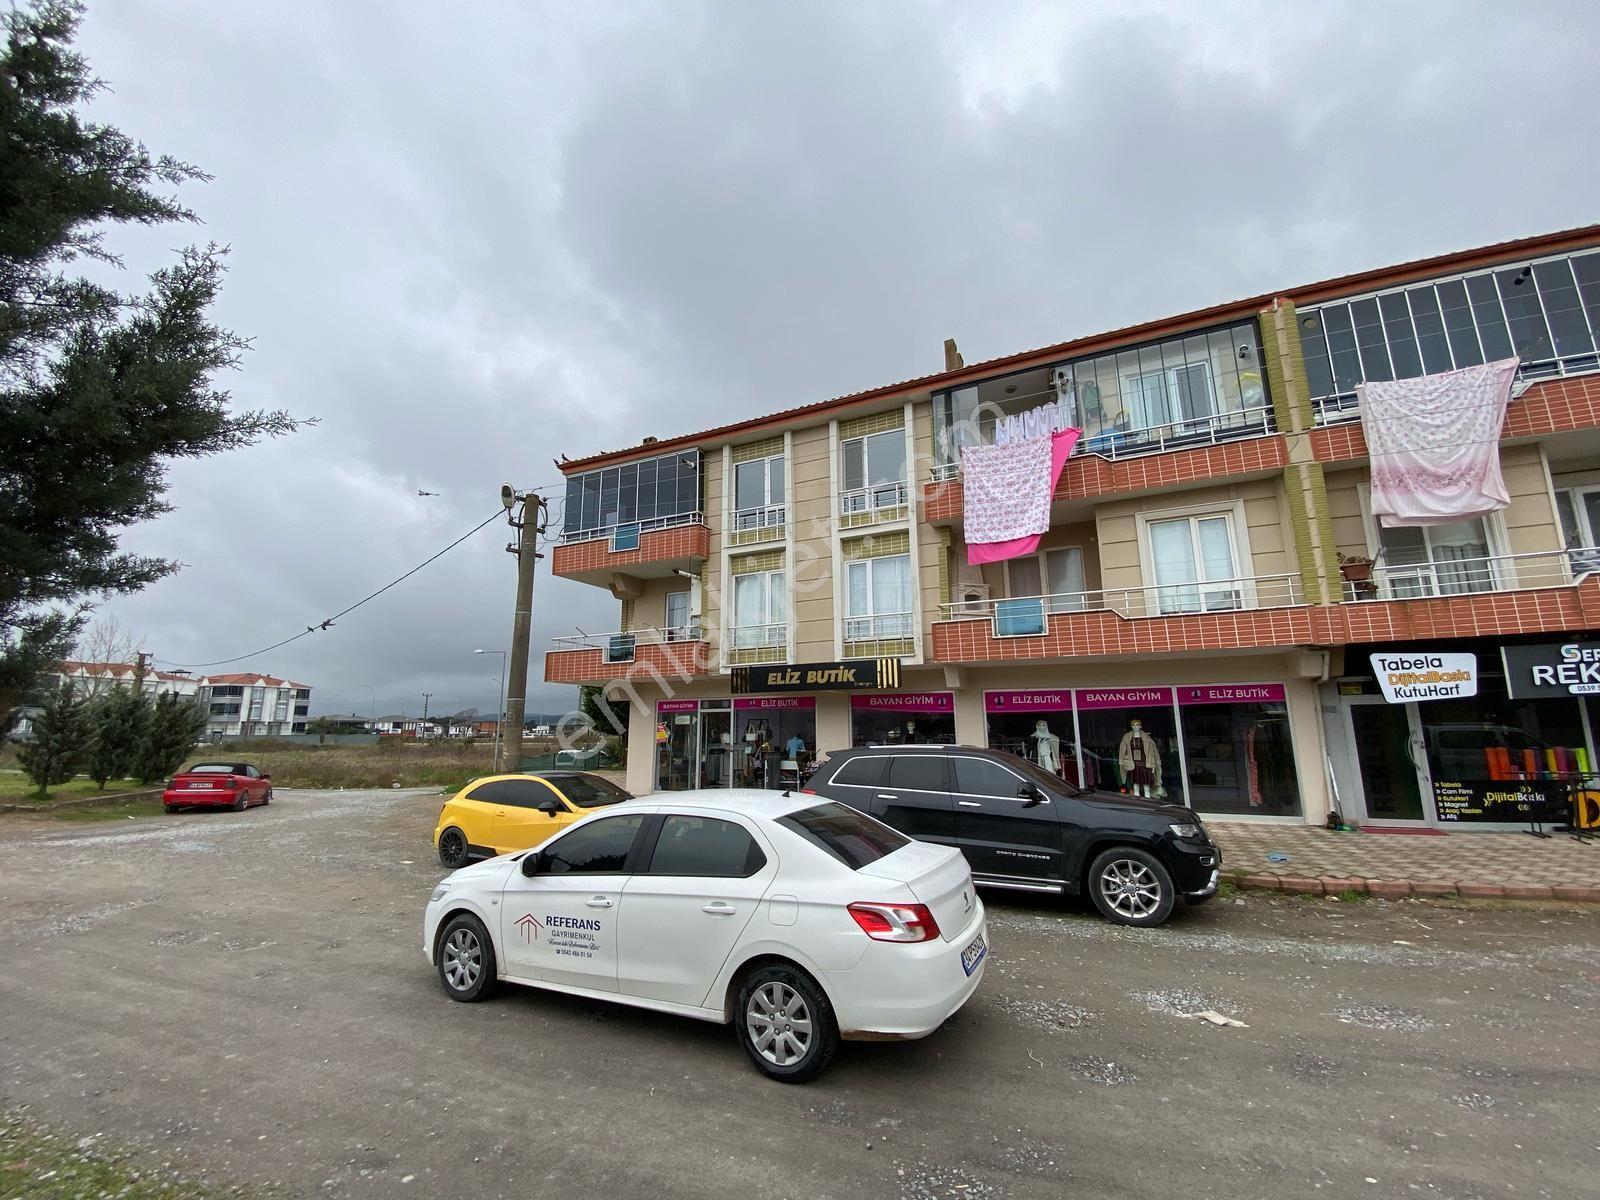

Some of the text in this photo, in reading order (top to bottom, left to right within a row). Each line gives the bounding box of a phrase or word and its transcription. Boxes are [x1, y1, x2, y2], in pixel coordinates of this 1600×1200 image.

[1379, 656, 1443, 672] Tabela
[767, 668, 801, 685] ELİZ
[806, 665, 856, 684] BUTİK
[1086, 691, 1161, 702] BAYAN GİYİM
[1209, 687, 1270, 699] ELİZ BUTİK
[1394, 684, 1460, 699] KutuHarf
[761, 698, 777, 707] ELİZ
[870, 695, 934, 706] BAYAN GİYİM
[1012, 693, 1062, 704] ELİZ BUTİK
[546, 915, 601, 931] REFERANS
